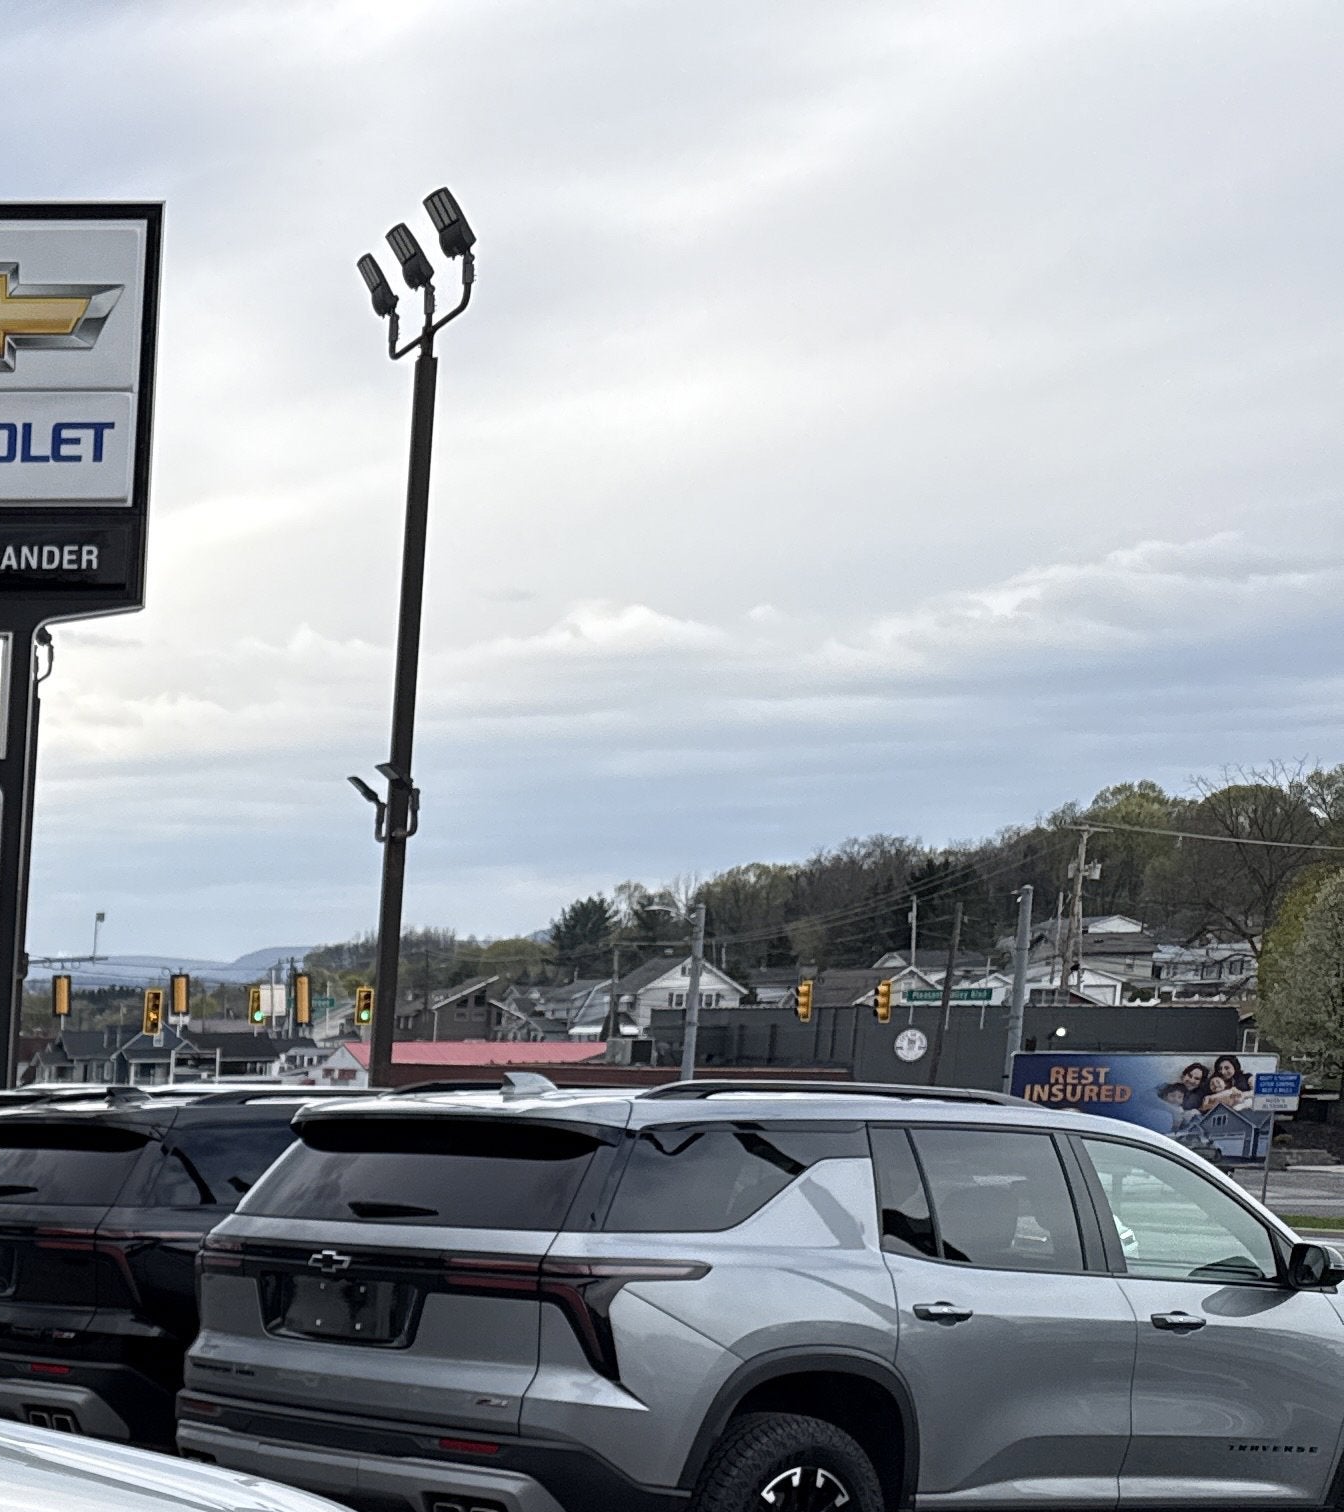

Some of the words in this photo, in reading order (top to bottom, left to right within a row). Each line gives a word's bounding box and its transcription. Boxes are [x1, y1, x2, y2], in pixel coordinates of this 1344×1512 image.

[1050, 1066, 1111, 1085] REST
[1024, 1084, 1132, 1103] INSURED
[1228, 1444, 1318, 1453] TRAVERSE
